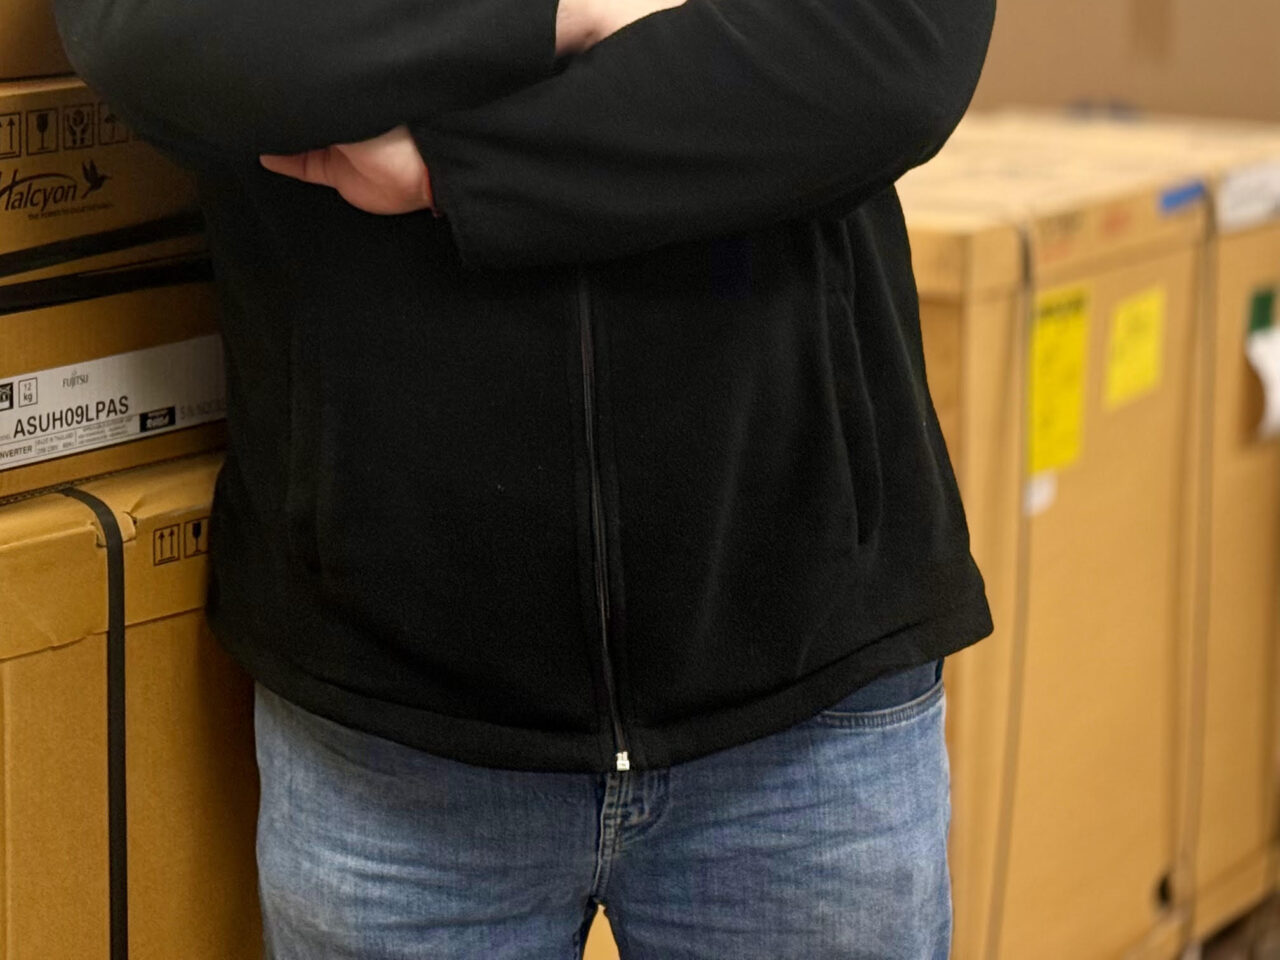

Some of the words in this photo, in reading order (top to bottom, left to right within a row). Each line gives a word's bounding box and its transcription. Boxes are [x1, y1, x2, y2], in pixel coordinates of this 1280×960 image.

[62, 371, 89, 389] FUJITSU
[23, 383, 33, 392] 12
[23, 392, 33, 403] kg
[13, 395, 130, 439] ASUH09LPAS
